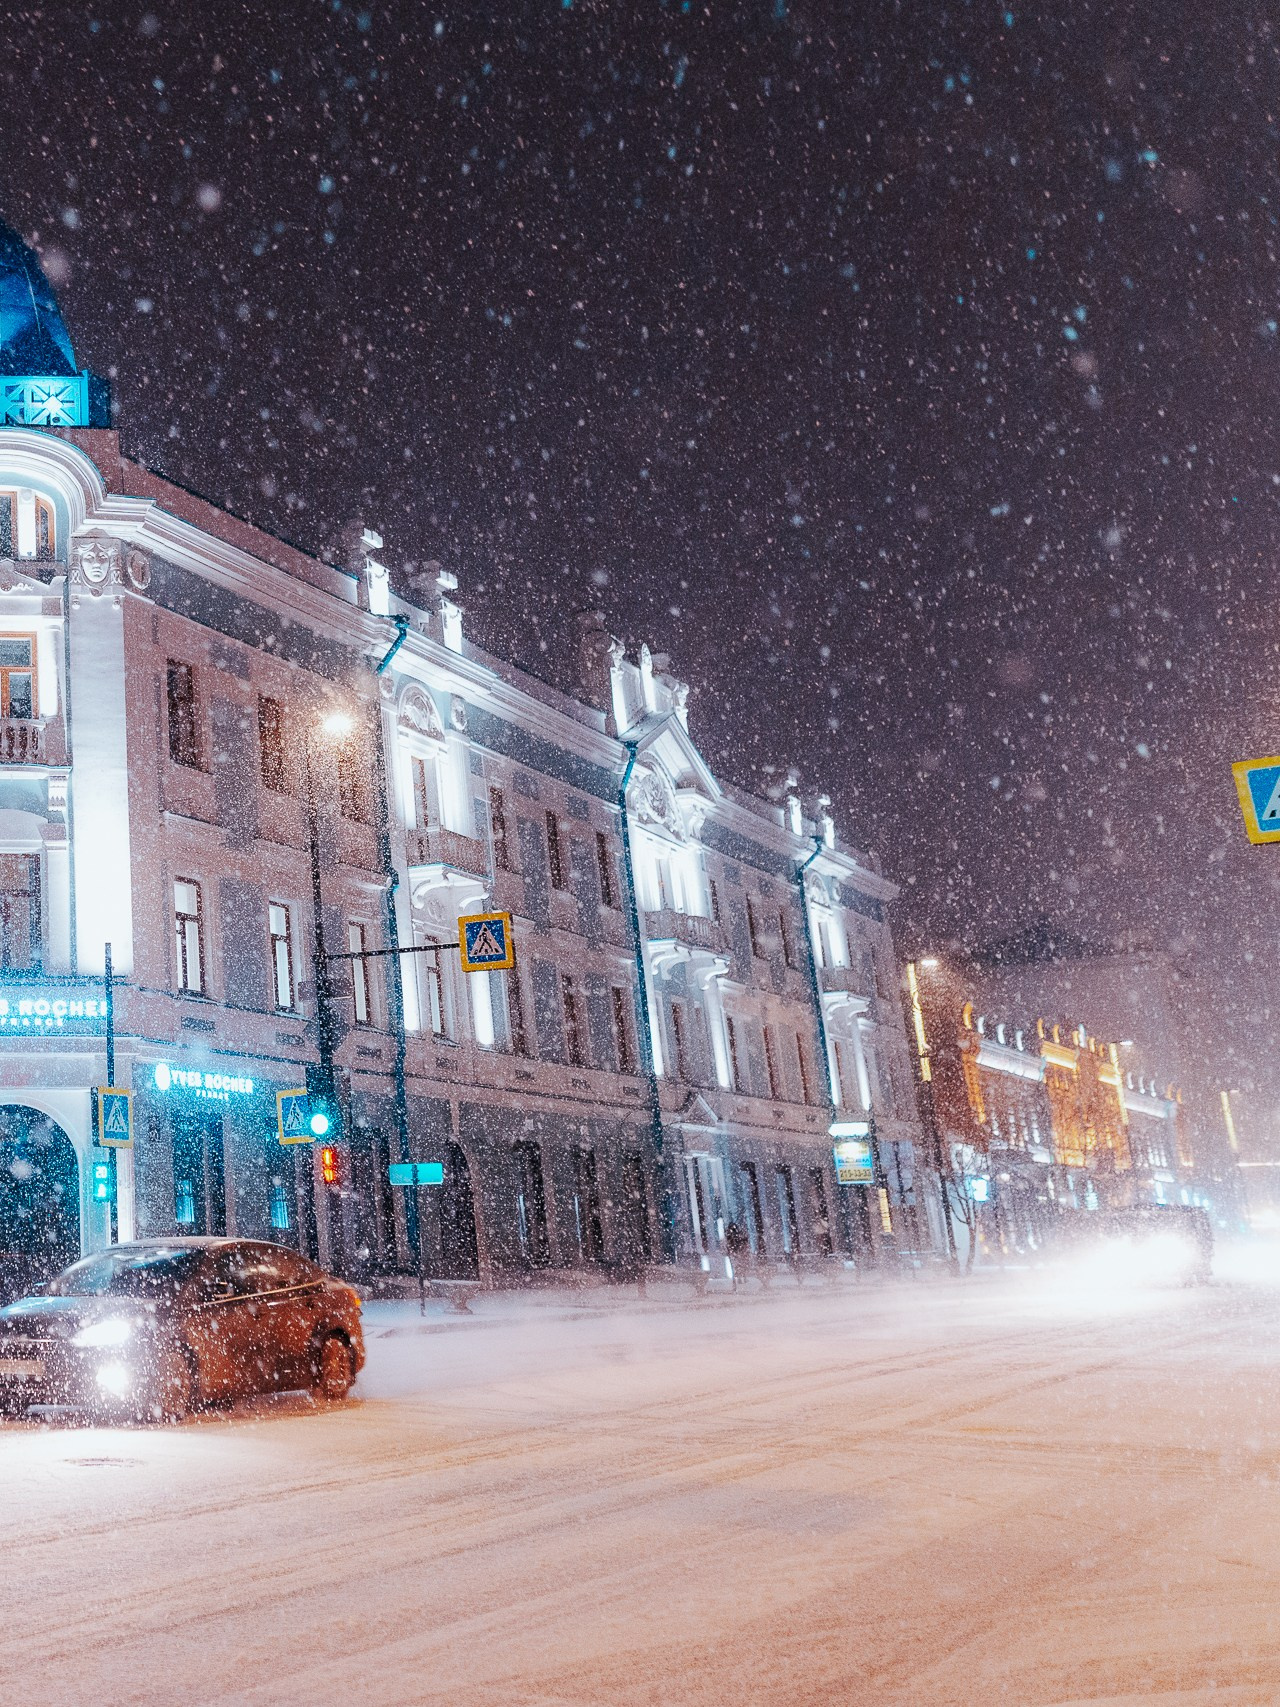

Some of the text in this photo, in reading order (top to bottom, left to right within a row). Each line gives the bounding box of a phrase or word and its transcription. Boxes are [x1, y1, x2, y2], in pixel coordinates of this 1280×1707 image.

[0, 1017, 64, 1027] FRANCE
[170, 1069, 254, 1094] YVES ROCHER
